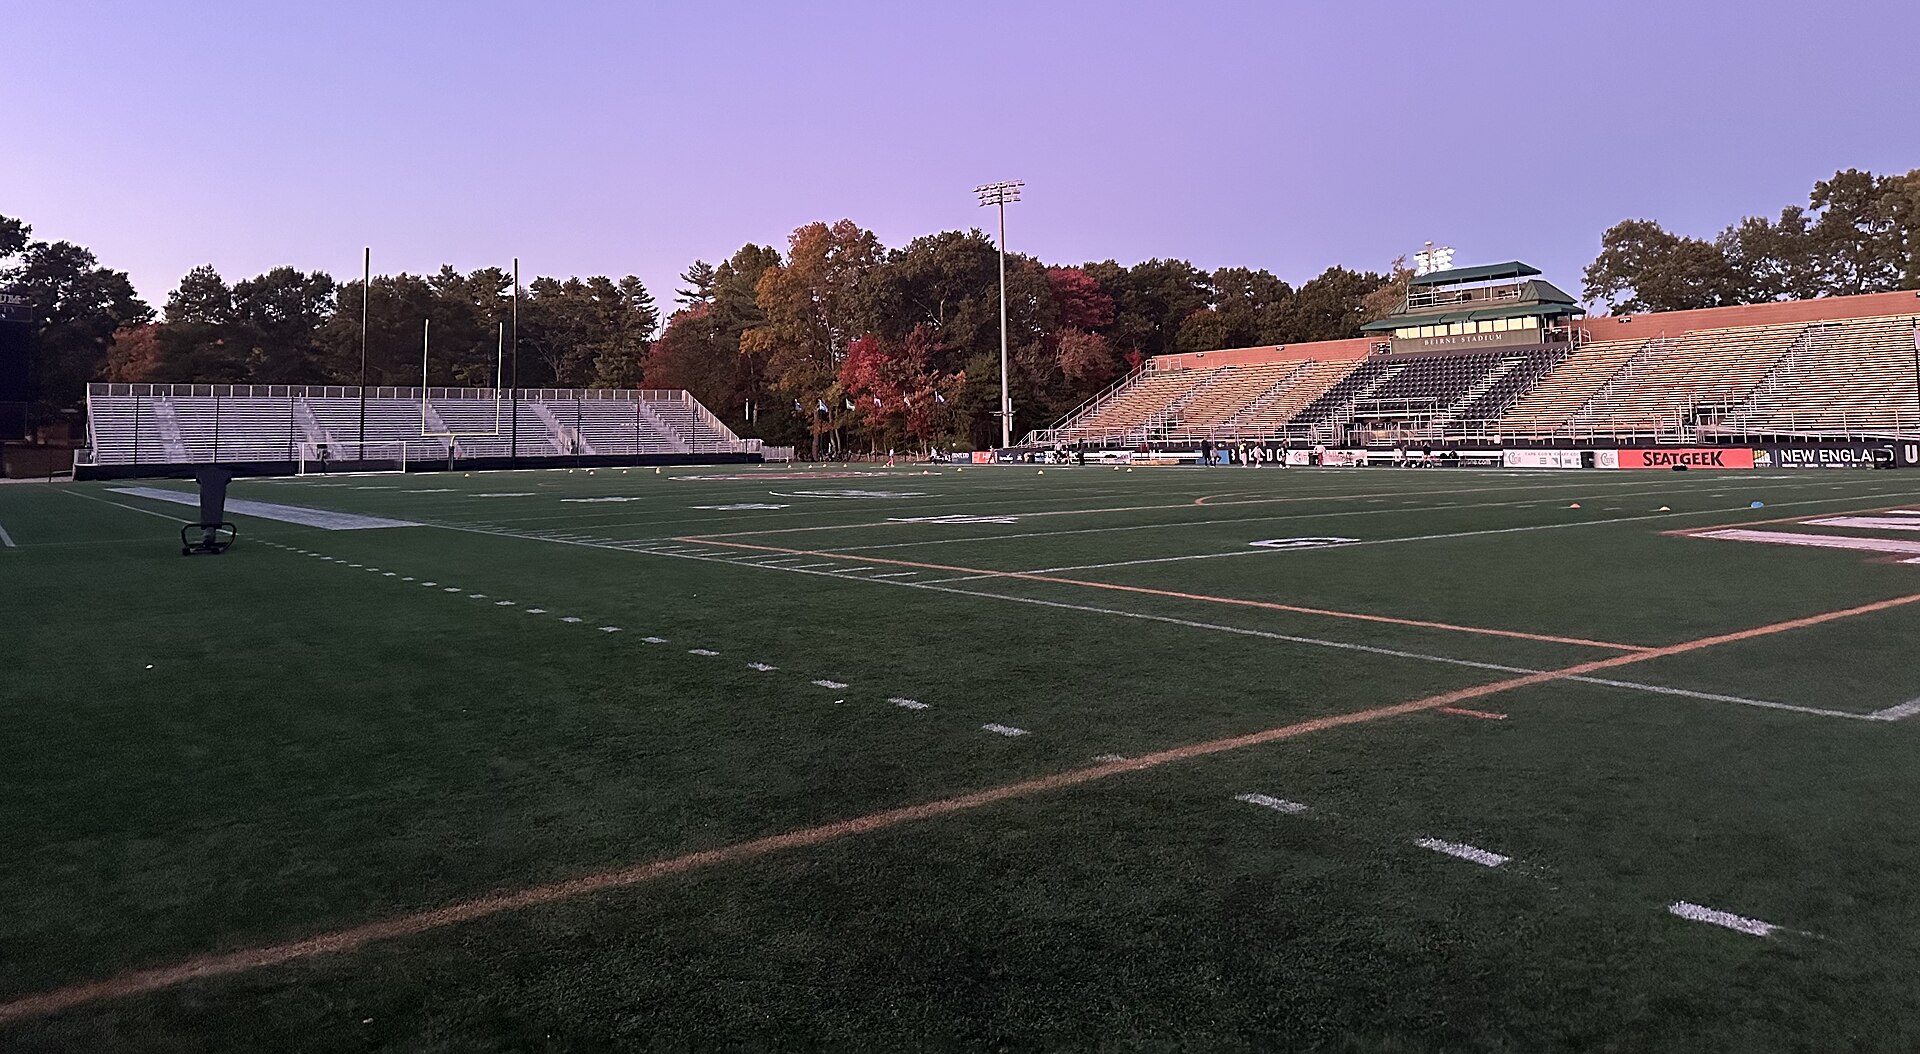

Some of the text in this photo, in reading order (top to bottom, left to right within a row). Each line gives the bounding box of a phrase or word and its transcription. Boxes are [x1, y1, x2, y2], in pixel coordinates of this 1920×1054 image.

[1461, 334, 1502, 343] STADIUM
[1642, 451, 1724, 467] SEATGEEK
[1780, 449, 1894, 462] NEW ENGLA
